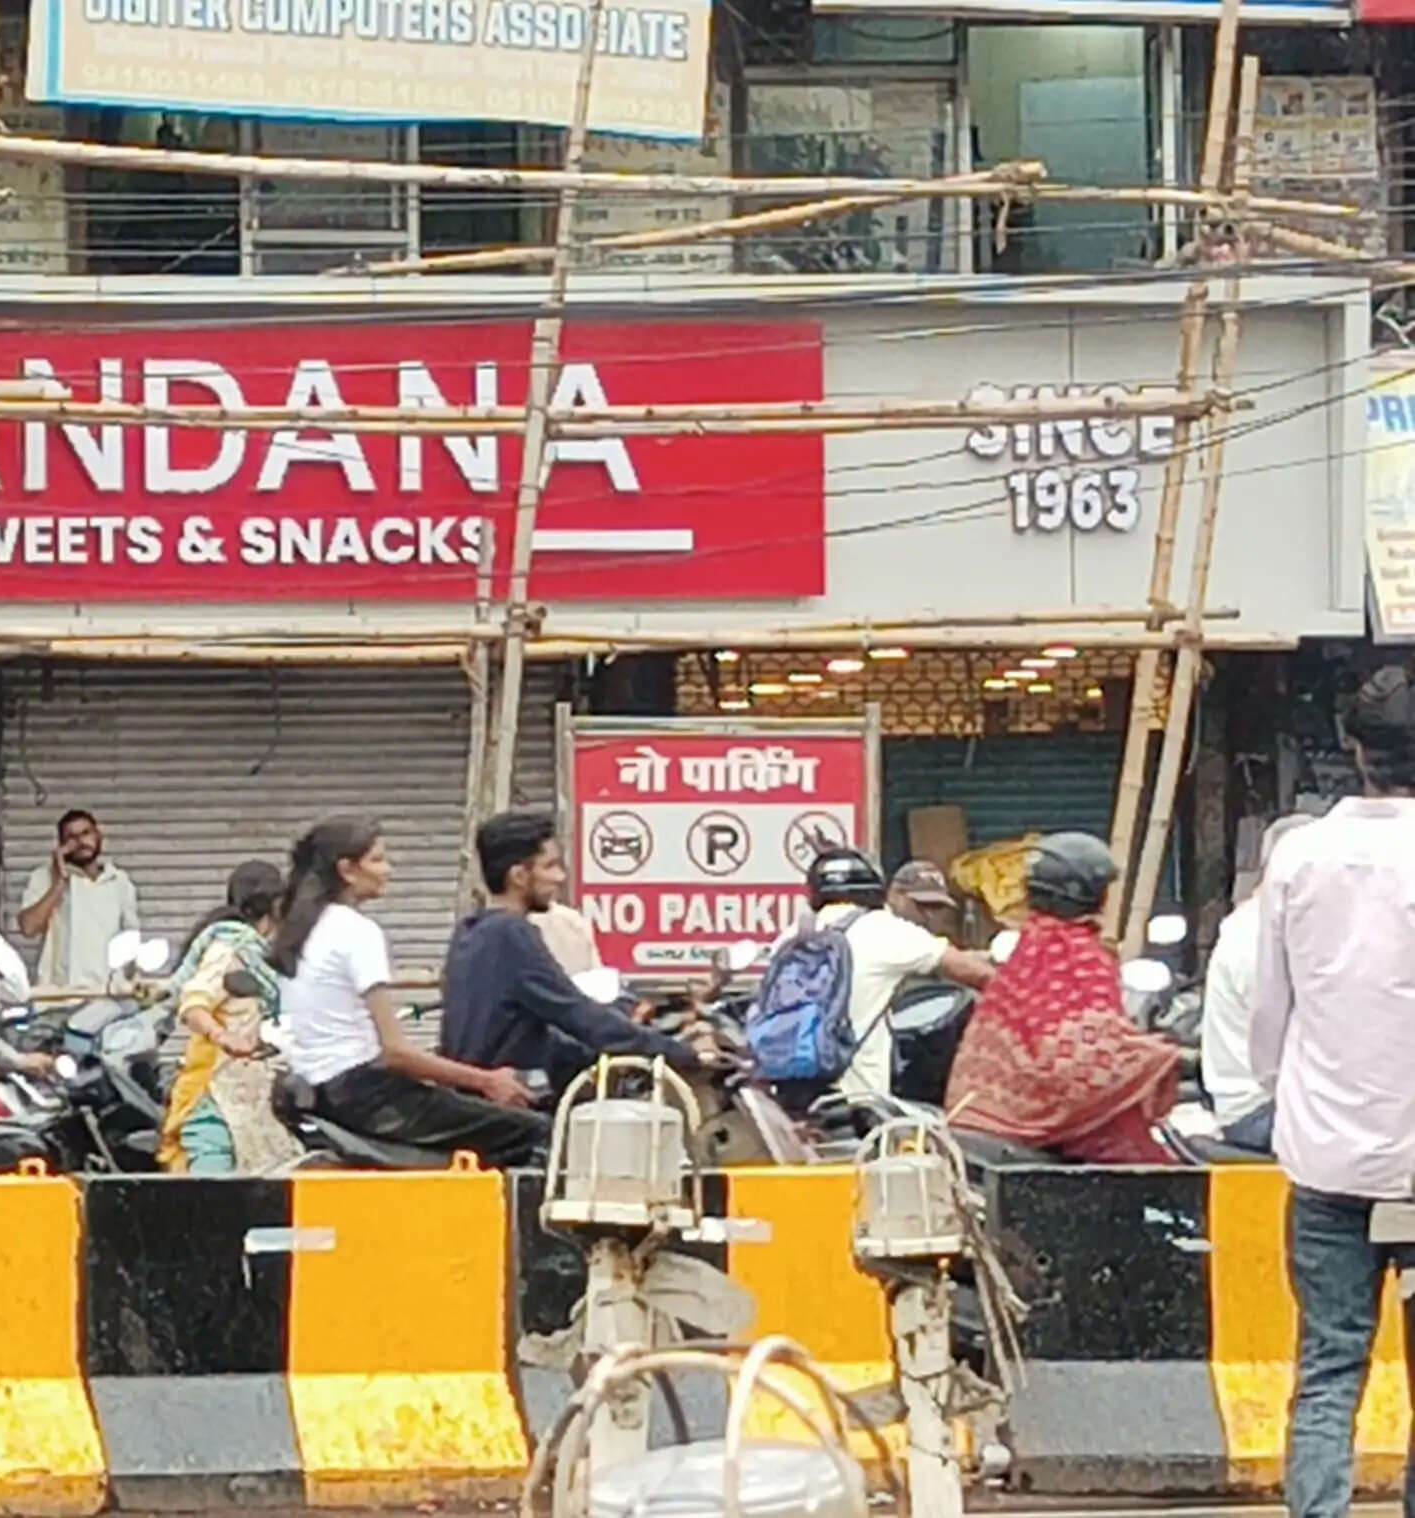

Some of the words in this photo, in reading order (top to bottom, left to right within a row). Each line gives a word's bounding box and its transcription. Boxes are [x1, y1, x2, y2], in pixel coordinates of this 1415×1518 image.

[240, 0, 473, 44] COMPUTERS
[966, 382, 1176, 461] SINCE
[1008, 468, 1142, 533] 1963
[177, 516, 228, 564] &
[240, 516, 489, 565] SNACKS
[615, 746, 672, 792] नो
[582, 893, 645, 933] NO
[659, 893, 809, 934] PARKI
